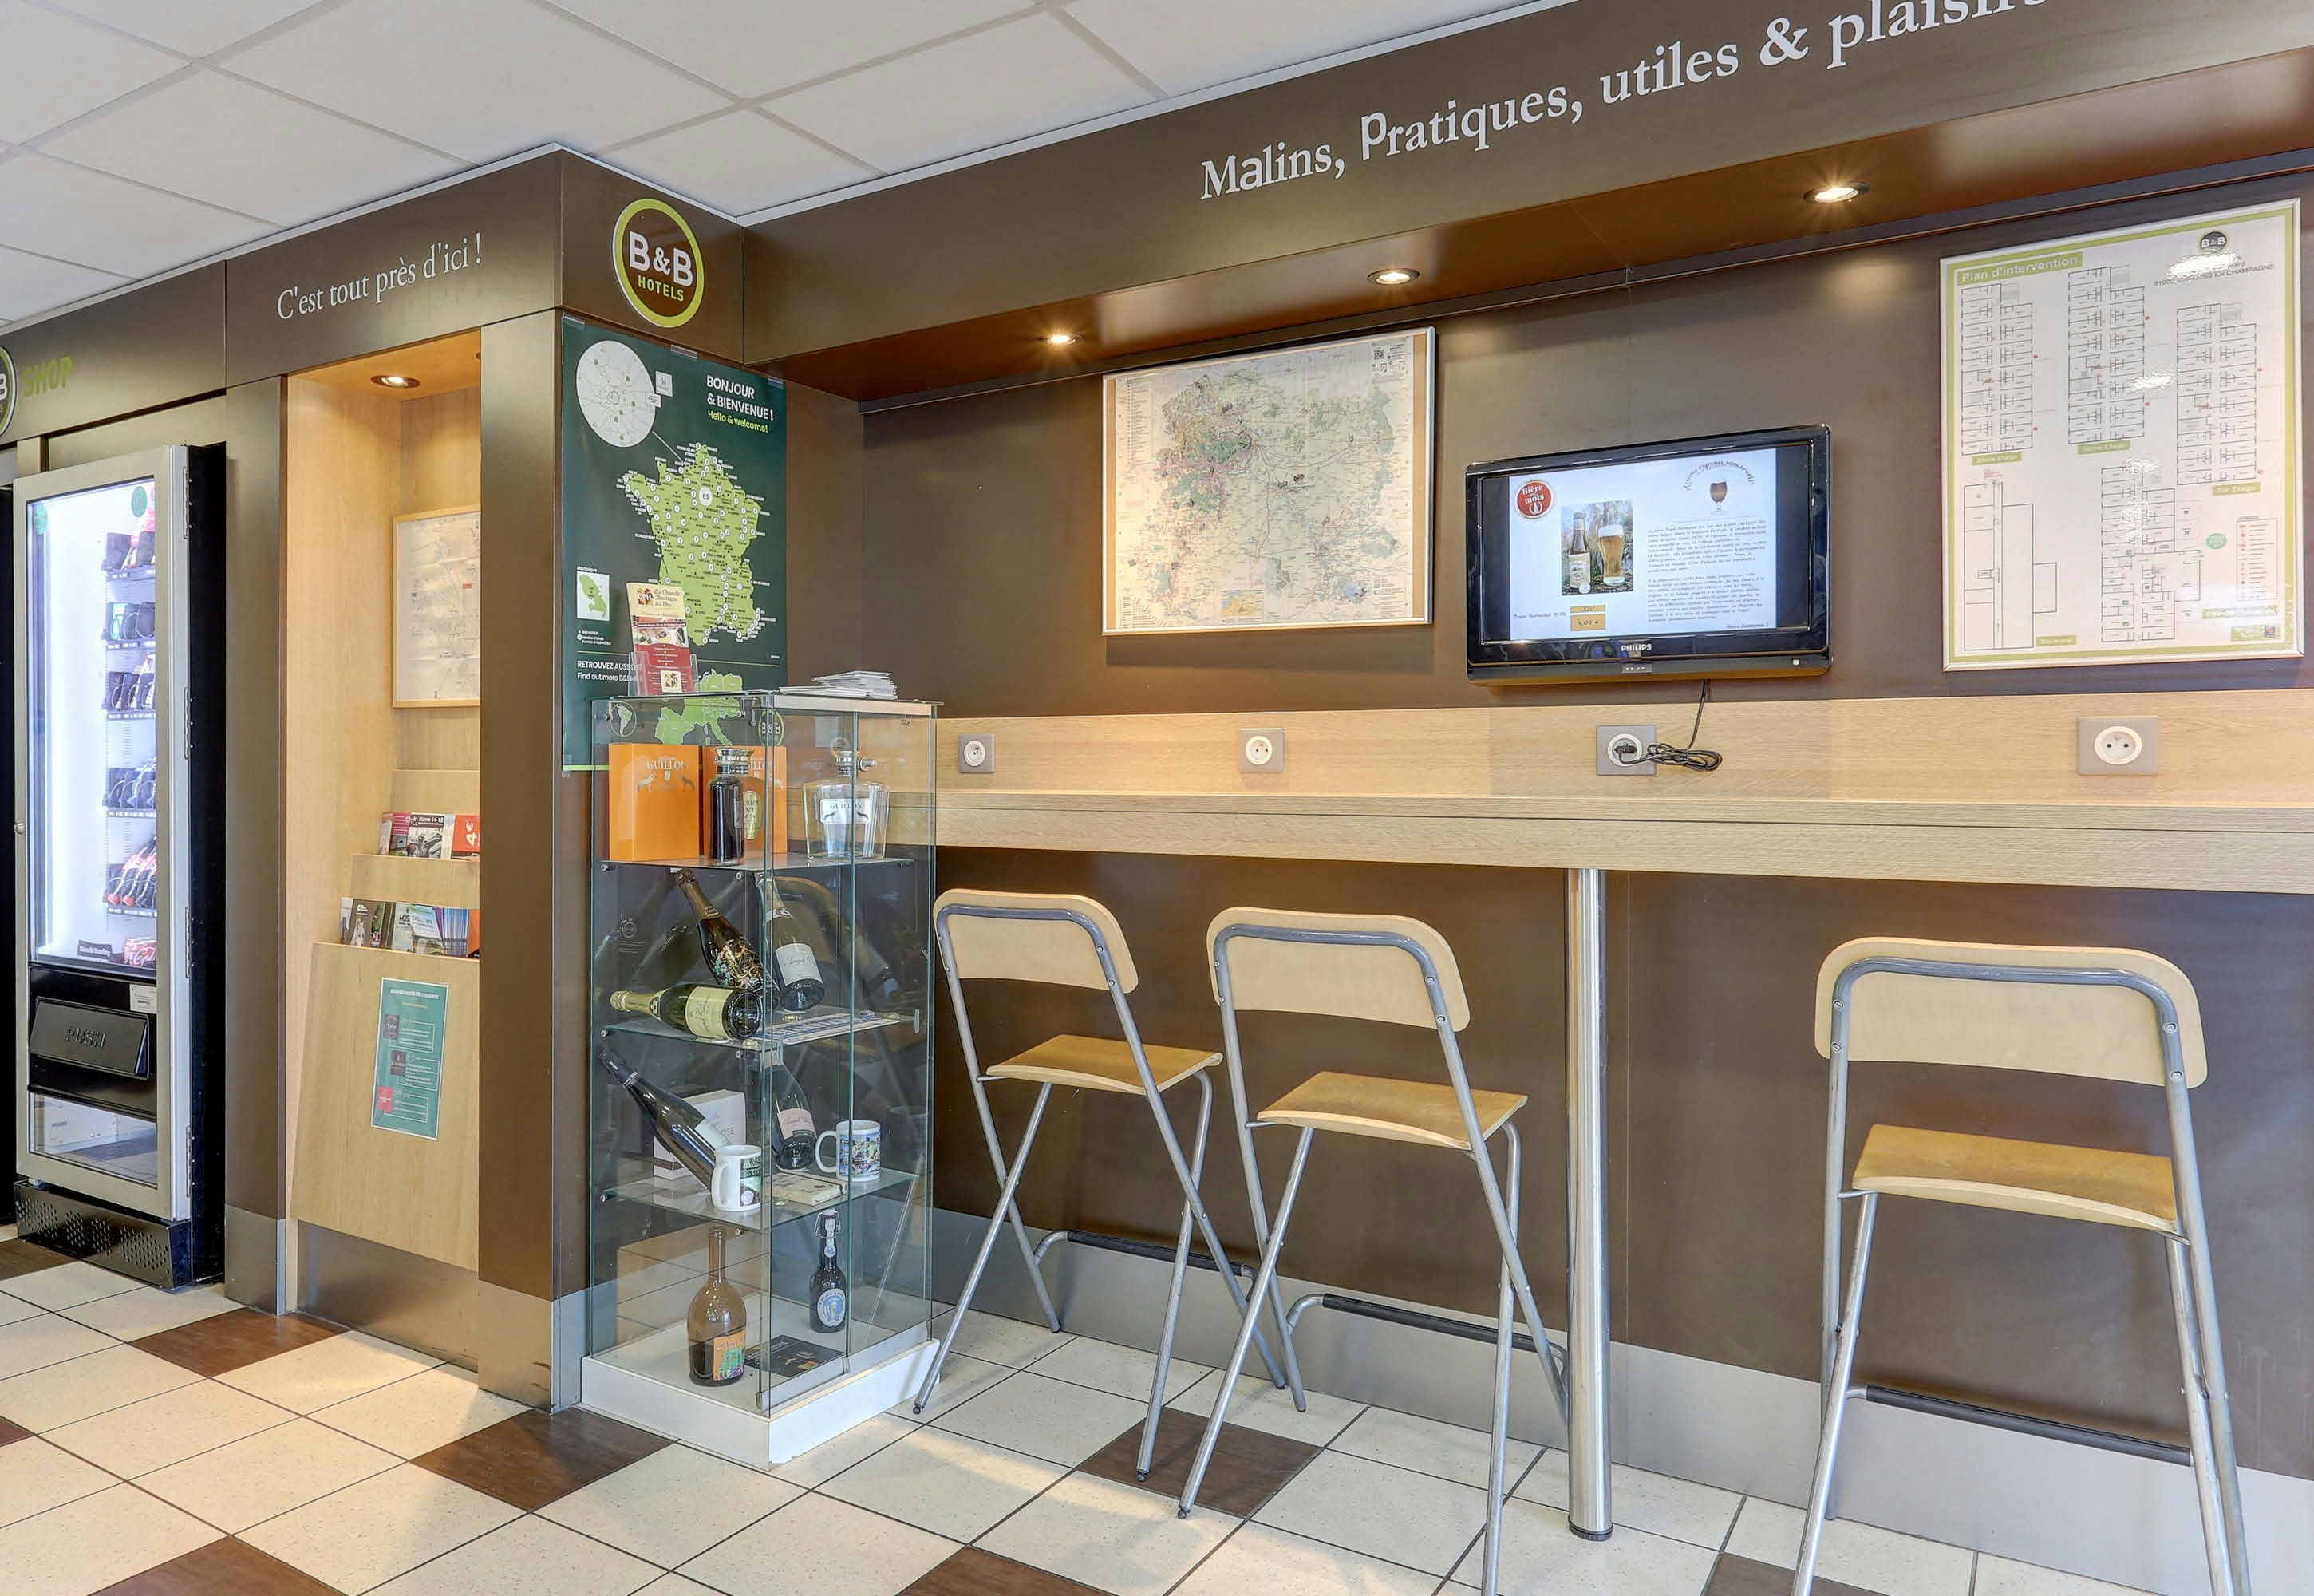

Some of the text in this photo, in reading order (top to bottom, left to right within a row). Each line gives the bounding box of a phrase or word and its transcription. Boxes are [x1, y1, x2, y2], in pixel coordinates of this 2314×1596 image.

[1200, 0, 2049, 200] Malins, Pratiques, utiles & plais
[630, 231, 693, 286] B&B
[1961, 256, 2077, 282] Plan d'intervention
[2226, 263, 2273, 276] CHAMPAGNE
[277, 231, 482, 319] C'est tout près d'ici !
[638, 275, 684, 302] HOTELS
[23, 356, 73, 397] SHOP
[707, 374, 755, 399] BONJOUR
[707, 393, 774, 421] & BIENVENUE !
[708, 409, 768, 433] Hello & welcome!
[1522, 484, 1544, 496] Bière
[1524, 493, 1546, 504] mois
[1621, 643, 1652, 652] PHILIPS
[577, 661, 614, 670] RETROUVEZ
[647, 760, 688, 770] GUILLON
[64, 1026, 107, 1048] PUSH
